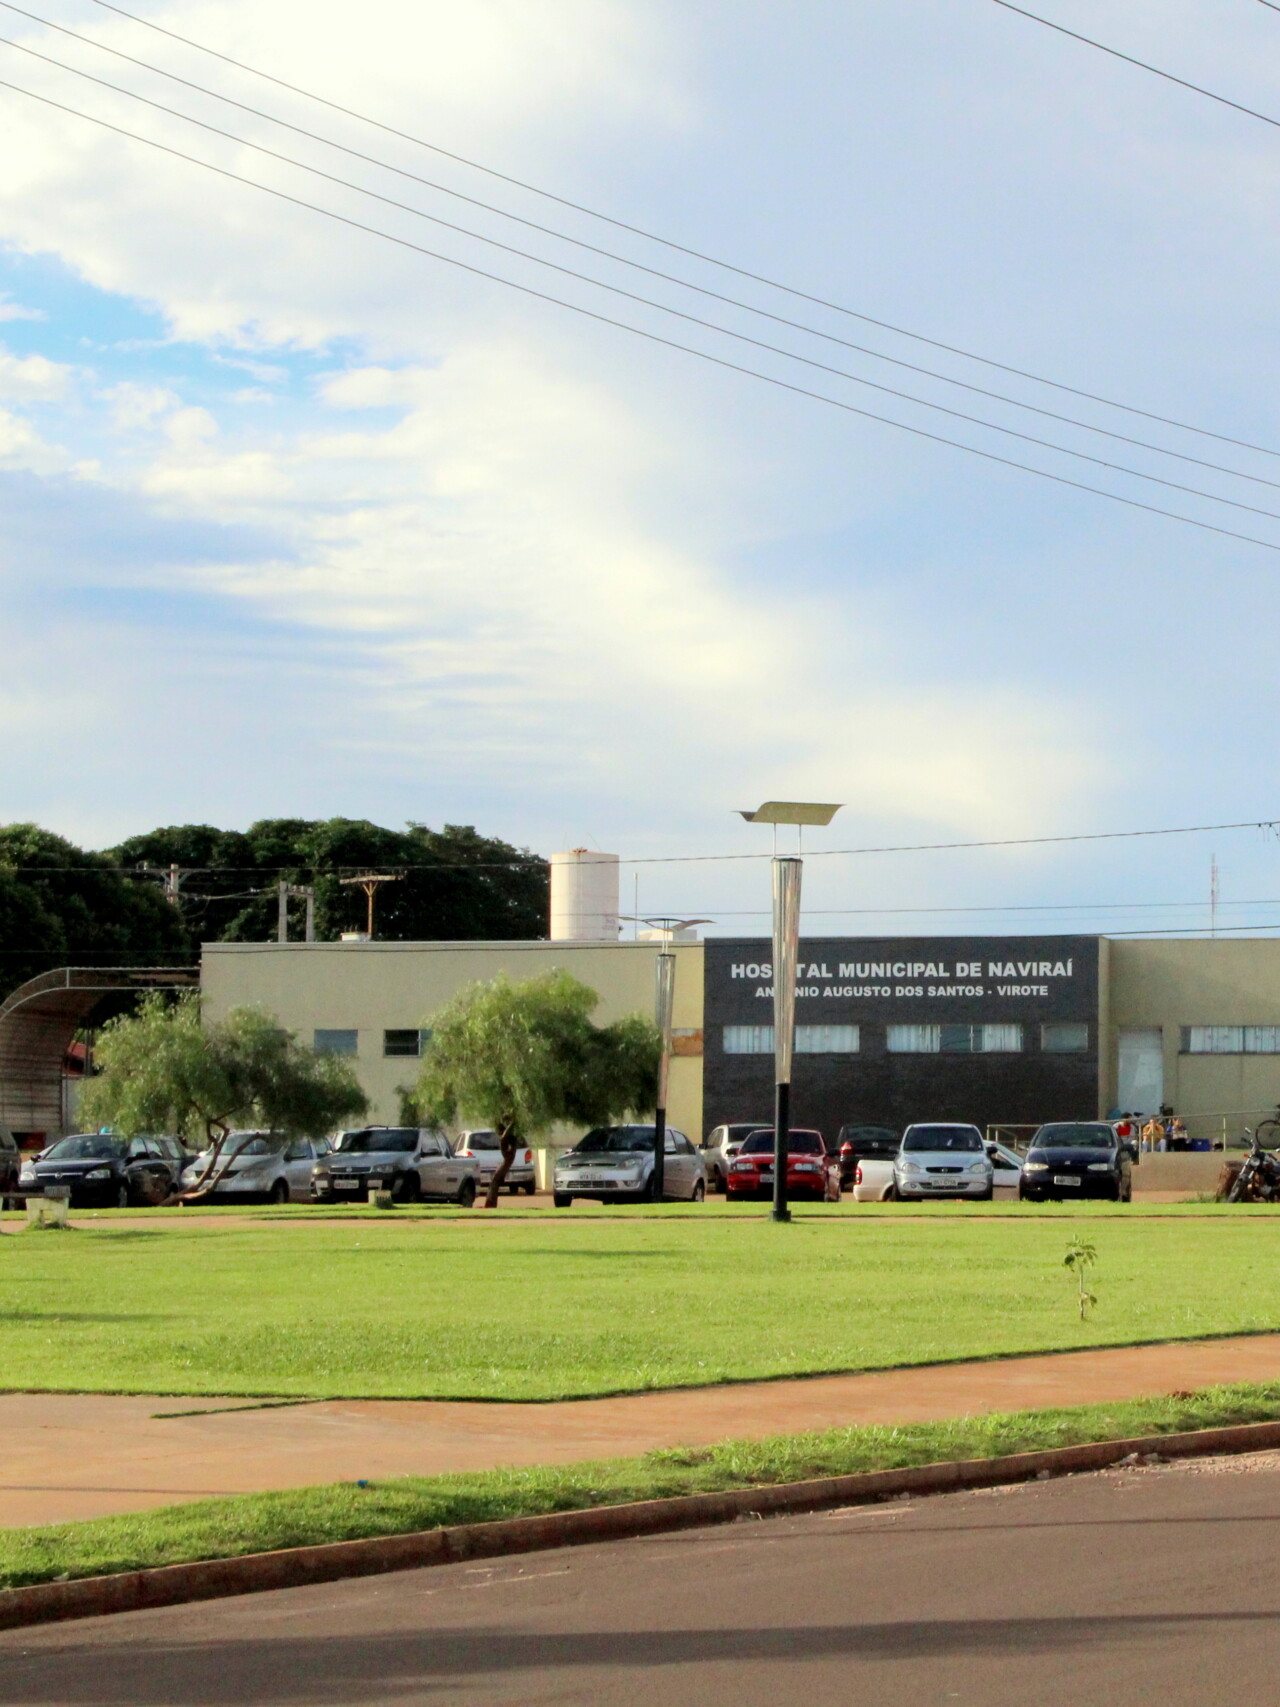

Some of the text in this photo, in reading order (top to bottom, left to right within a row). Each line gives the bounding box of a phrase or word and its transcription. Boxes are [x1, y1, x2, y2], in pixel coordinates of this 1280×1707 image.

[731, 959, 1073, 979] HOSTAL MUNICIPAL DE NAVIRAÍ
[755, 987, 819, 997] ANNIO
[823, 986, 891, 997] AUGUSTO
[895, 986, 924, 997] DOS
[927, 985, 984, 997] SANTOS
[997, 985, 1048, 996] VIROTE
